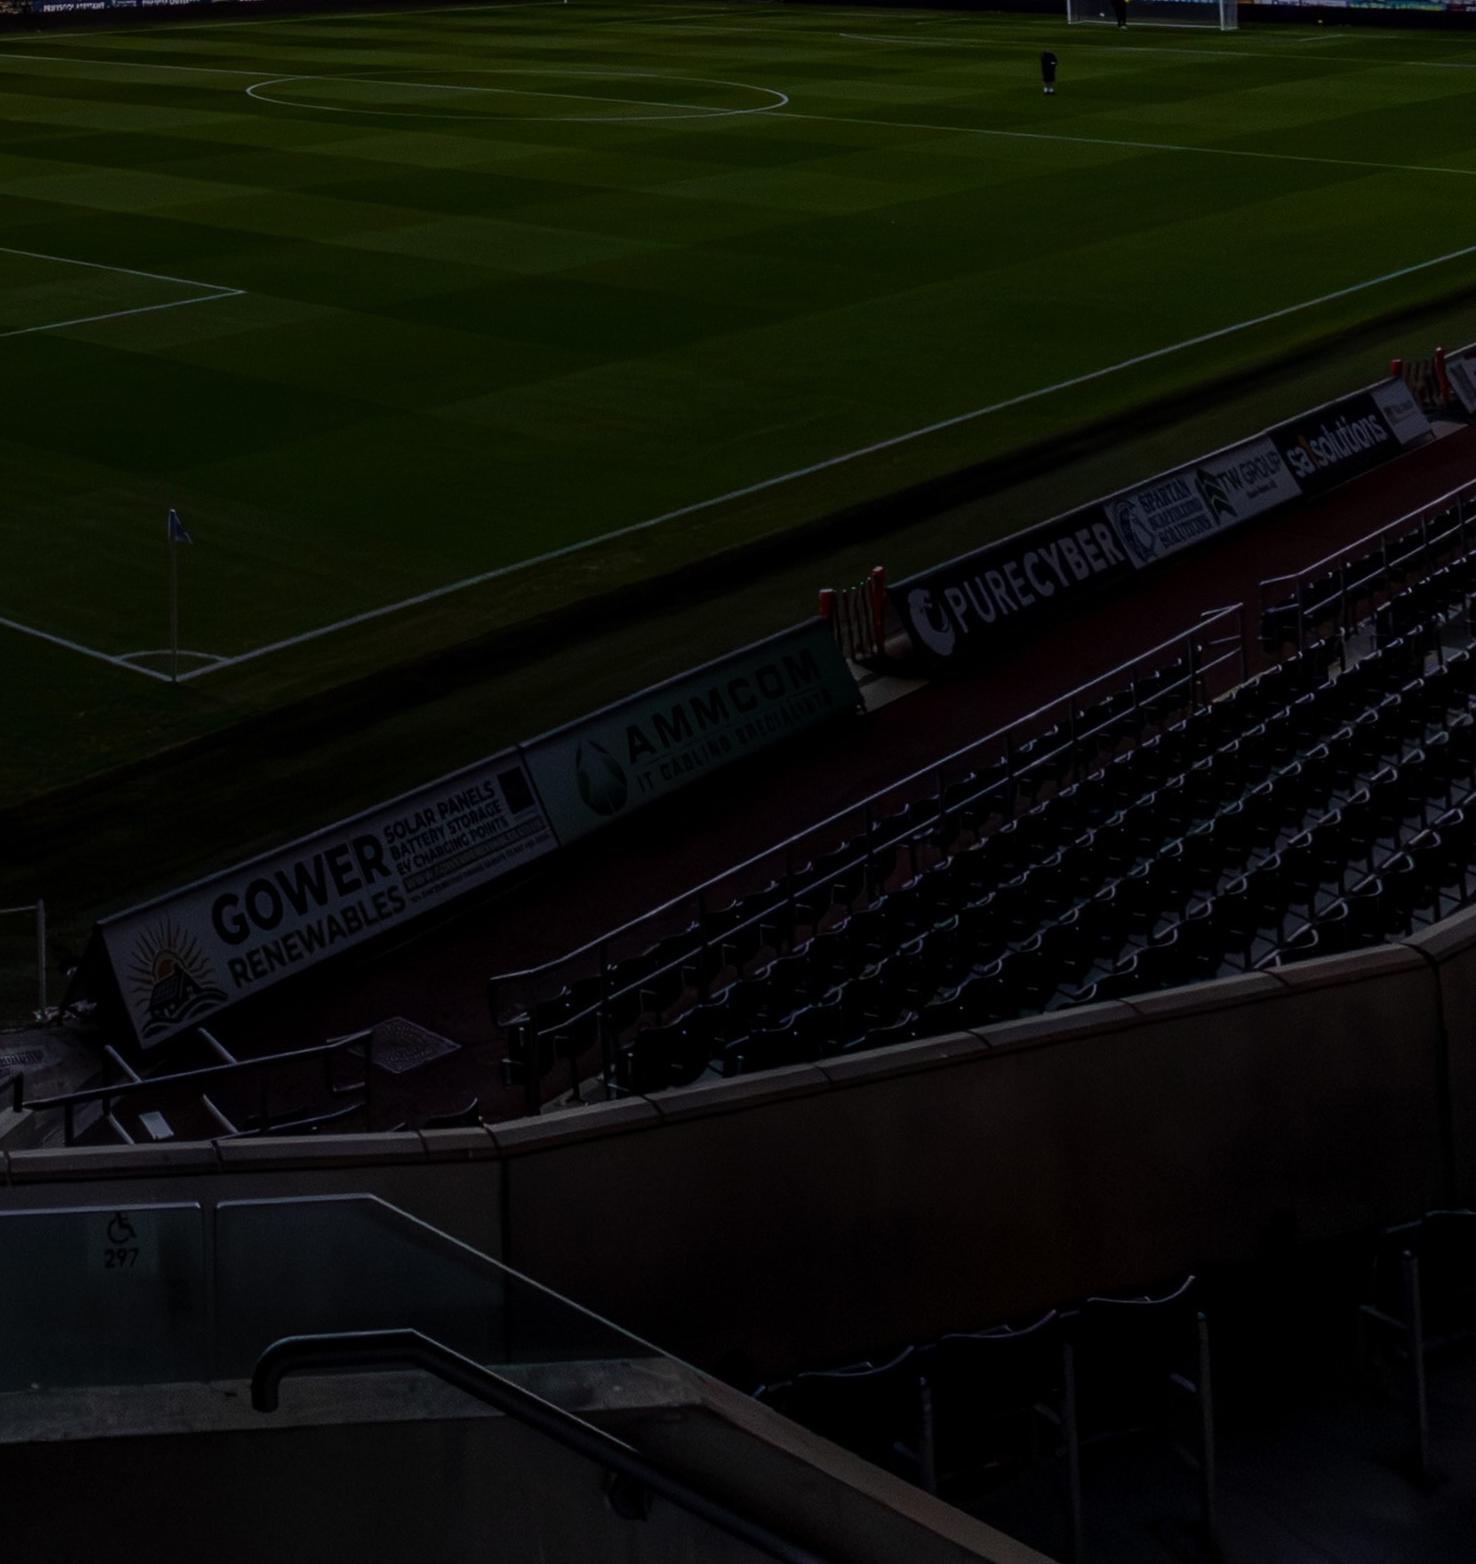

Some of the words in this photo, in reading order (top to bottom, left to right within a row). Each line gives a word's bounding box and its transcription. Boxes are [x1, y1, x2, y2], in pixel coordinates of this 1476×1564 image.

[1217, 467, 1244, 491] TW
[1240, 450, 1282, 484] GROUP
[1286, 414, 1389, 479] sa1solutions
[1138, 477, 1191, 514] SPARTAN
[944, 521, 1128, 635] PURECYBER
[625, 649, 822, 765] AMMCOM
[636, 771, 654, 793] IT
[660, 735, 732, 781] CABLING
[737, 688, 834, 746] SPECIALISTS
[383, 807, 436, 844] SOLAR
[436, 780, 496, 820] PANELS
[390, 826, 446, 861] BATTERY
[447, 800, 502, 836] STORAGE
[396, 859, 412, 876] EV
[413, 833, 471, 868] CHARGING
[470, 814, 509, 842] POINTS
[212, 834, 392, 945] GOWER
[228, 885, 406, 987] RENEWABLES
[105, 1248, 138, 1268] 297
